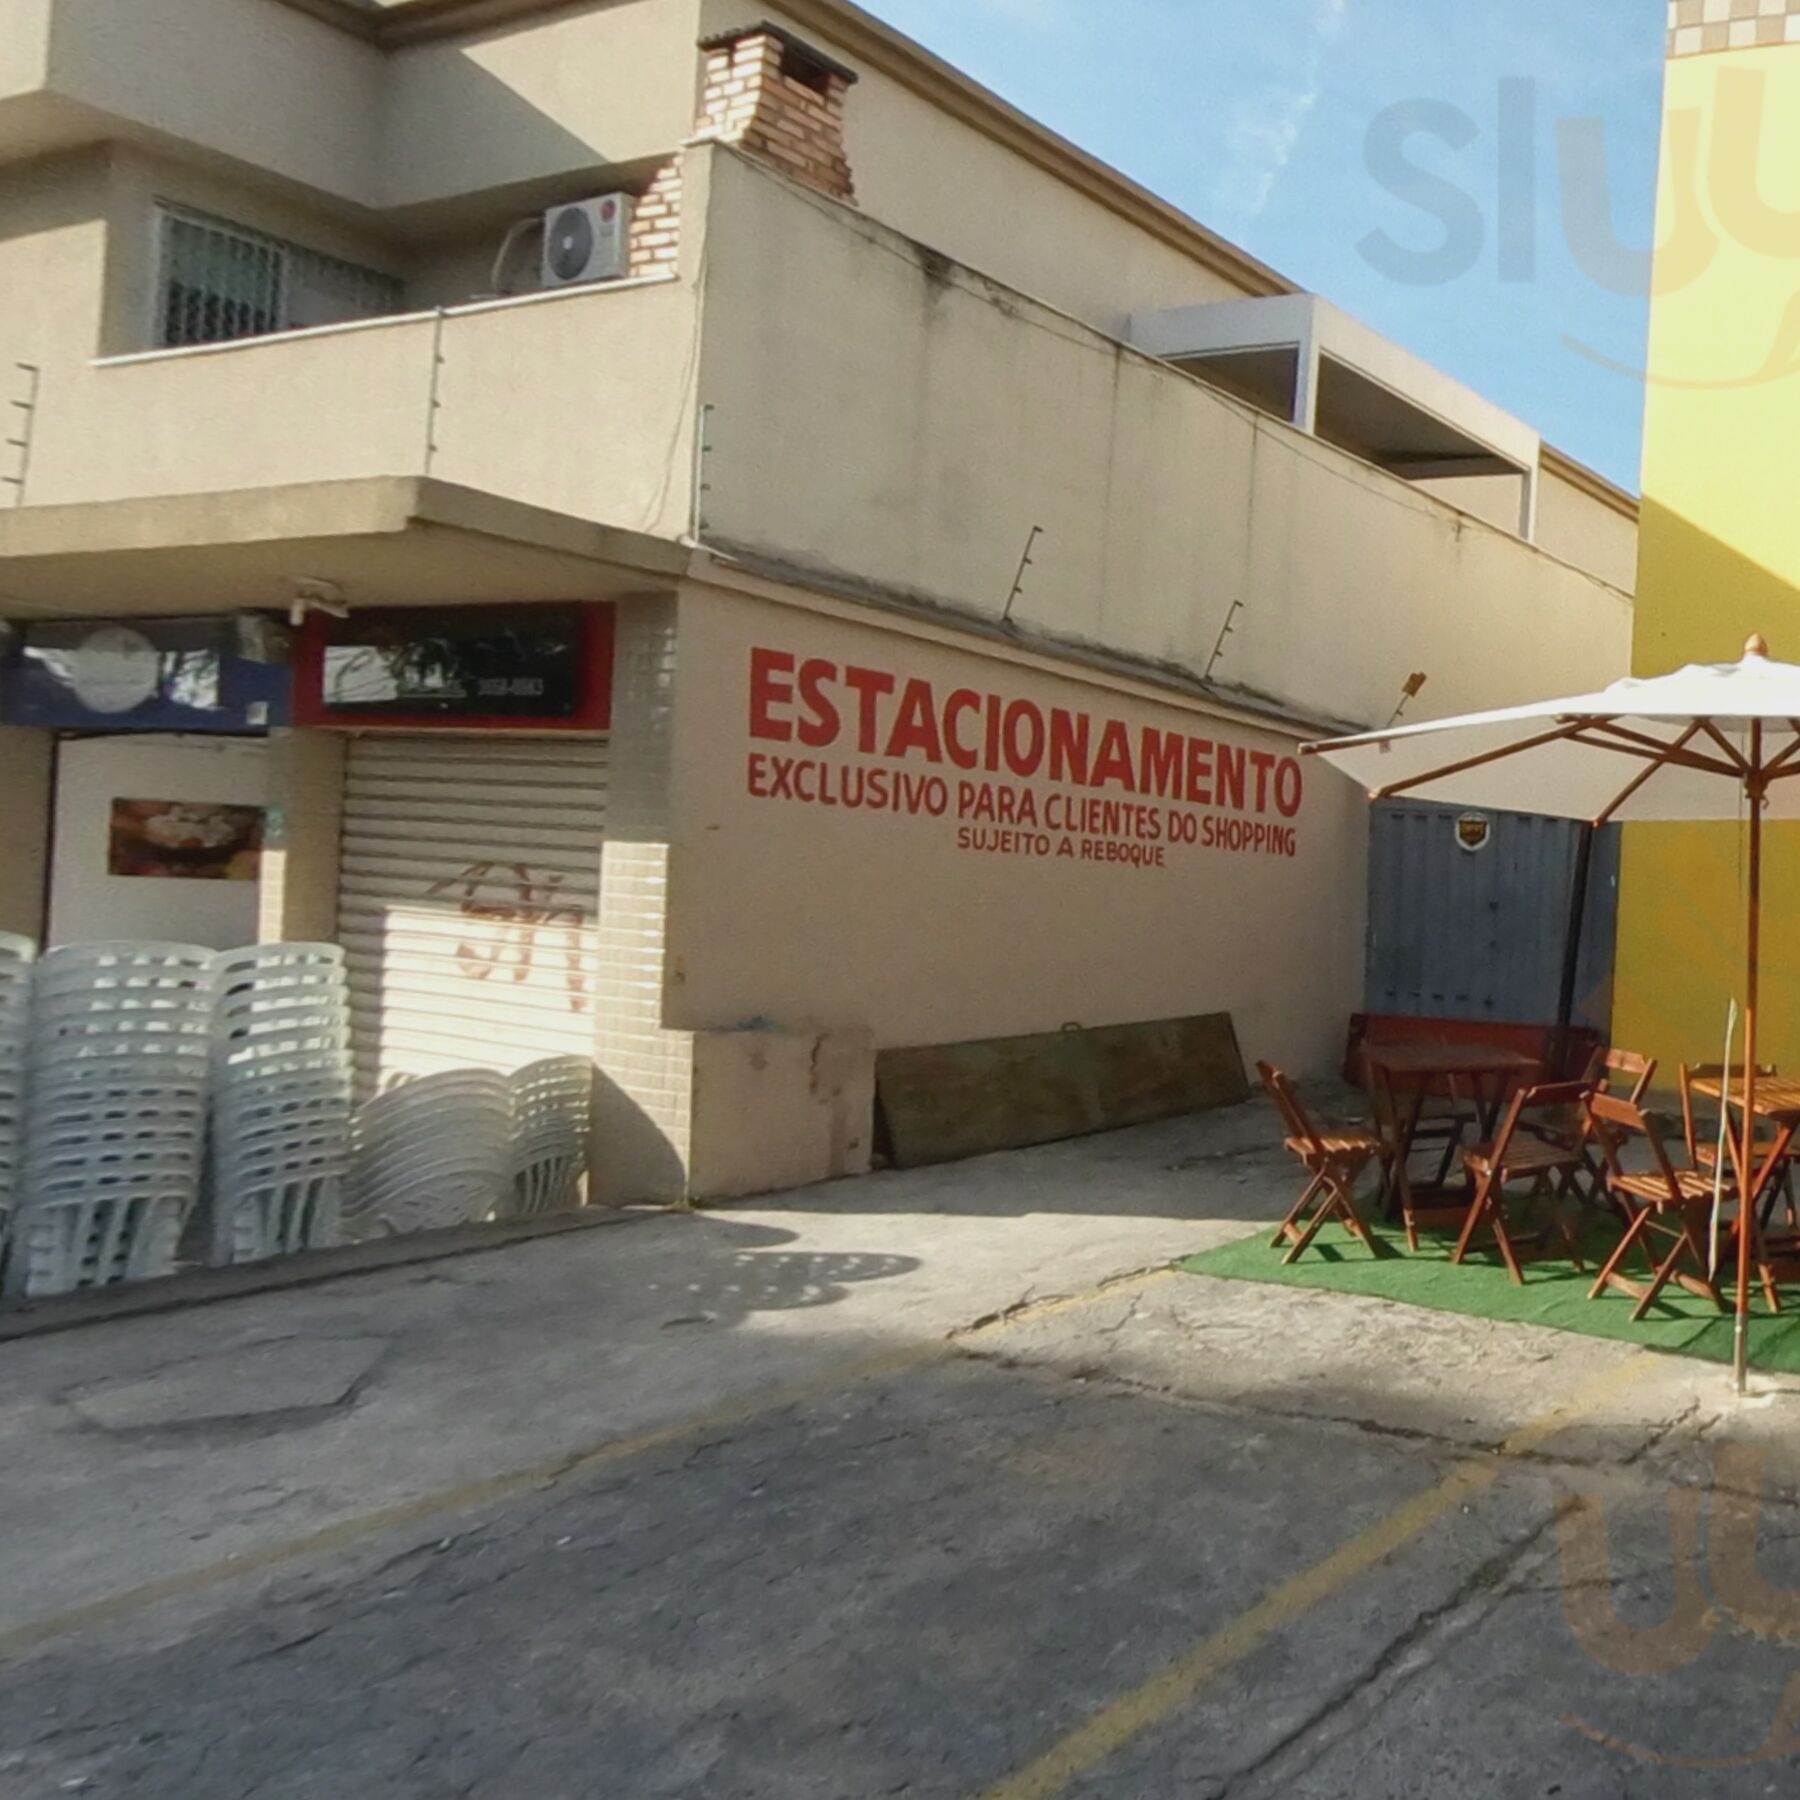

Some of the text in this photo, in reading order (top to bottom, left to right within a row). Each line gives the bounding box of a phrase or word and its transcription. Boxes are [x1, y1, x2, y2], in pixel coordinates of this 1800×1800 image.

[748, 648, 1304, 818] ESTACIONAMENTO
[747, 752, 1297, 858] EXCLUSIVO PARA CLIENTES DO SHOPPING
[957, 826, 1166, 869] SUJEITO A REBOQUE
